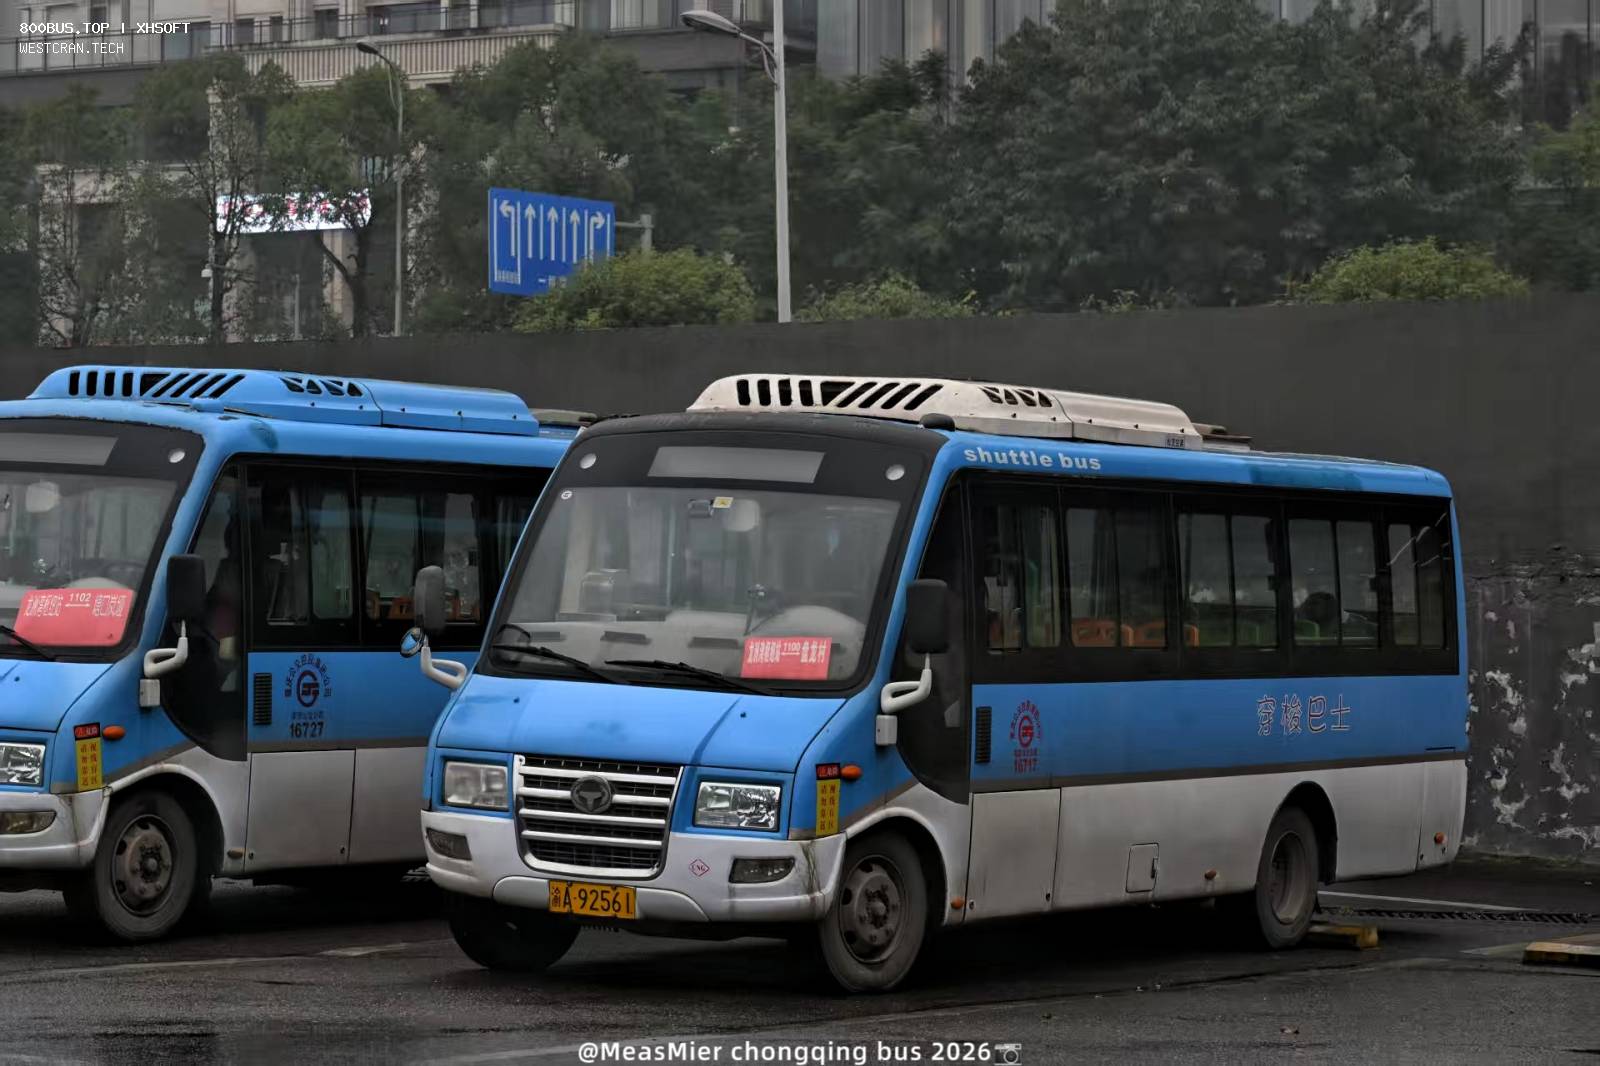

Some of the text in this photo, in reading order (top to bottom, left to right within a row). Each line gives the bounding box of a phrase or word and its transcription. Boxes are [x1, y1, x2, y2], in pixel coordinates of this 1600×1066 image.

[964, 447, 1101, 470] shuttle bus
[68, 592, 92, 602] 1102
[289, 721, 324, 738] 16727
